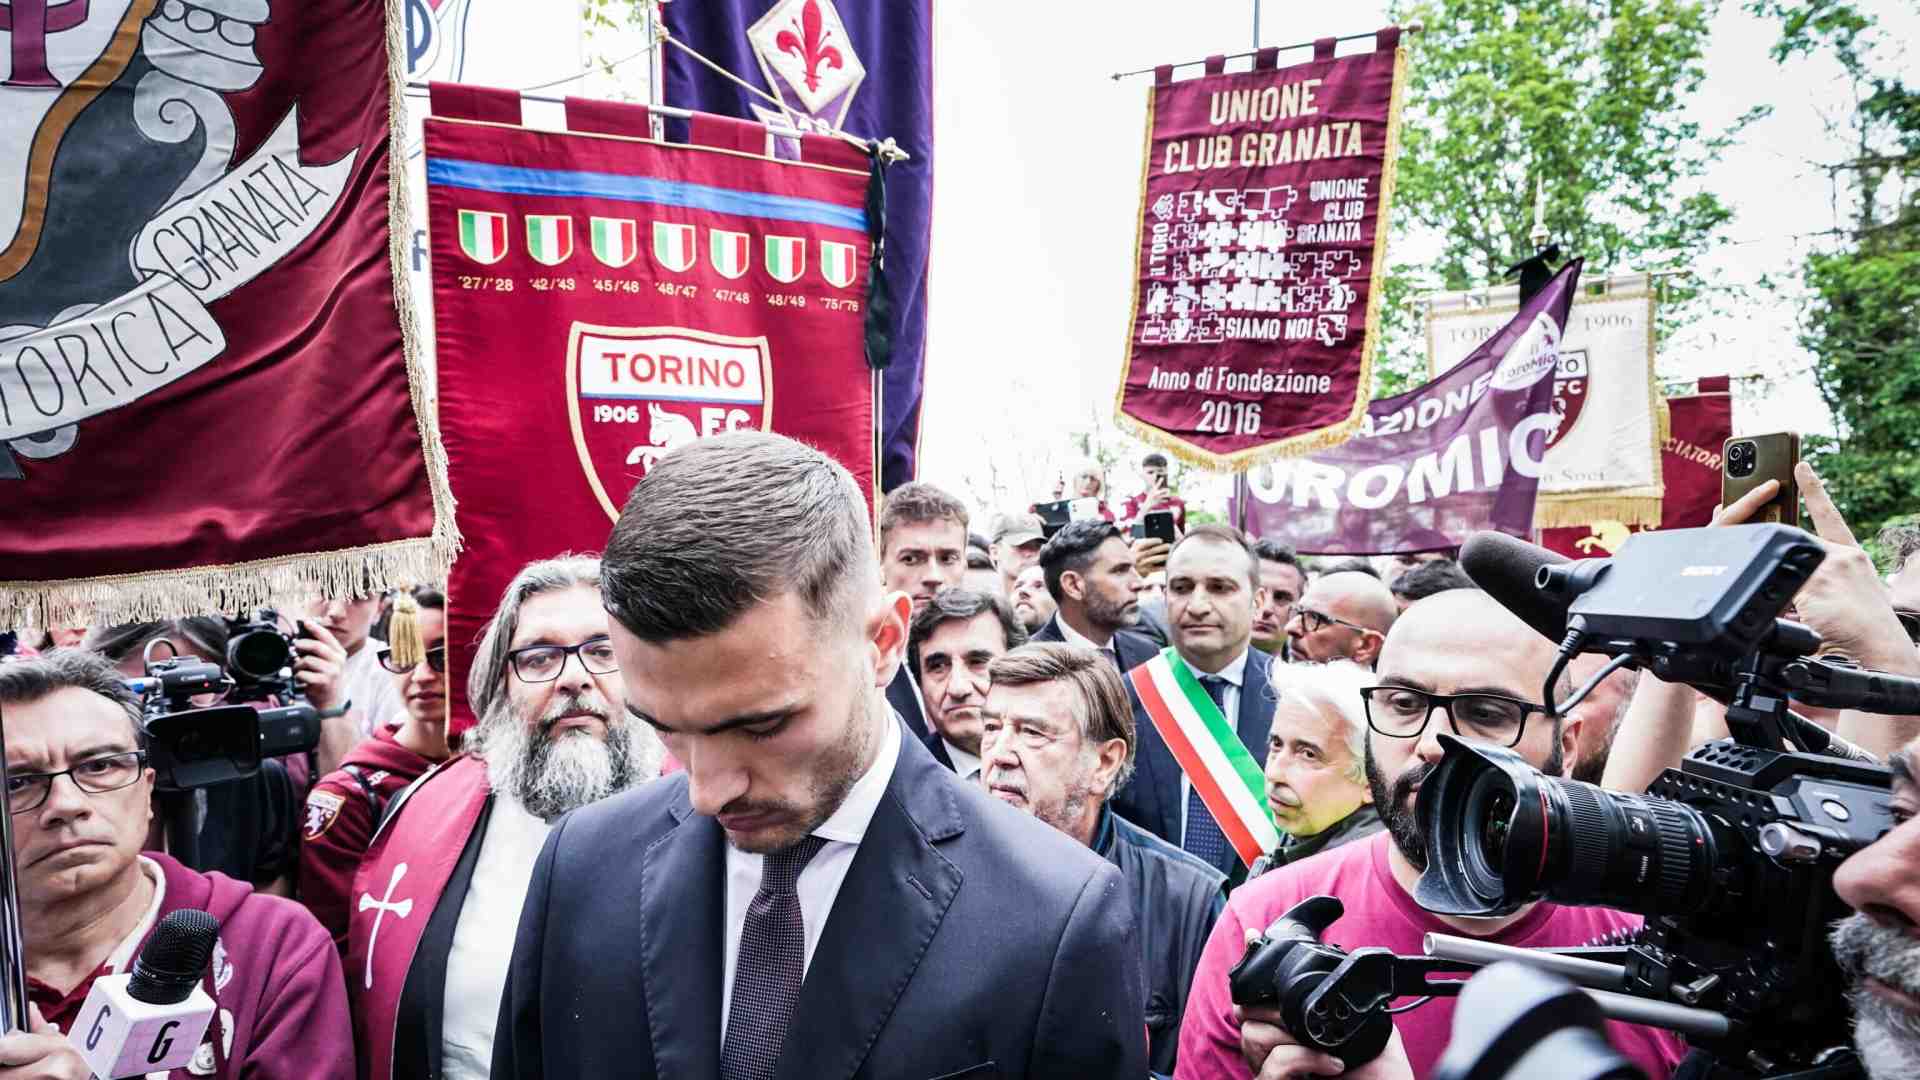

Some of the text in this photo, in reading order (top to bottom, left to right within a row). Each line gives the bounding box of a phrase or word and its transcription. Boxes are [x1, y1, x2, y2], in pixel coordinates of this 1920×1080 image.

[1209, 79, 1322, 126] UNIONE
[1163, 121, 1363, 174] CLUB GRANATA
[1309, 178, 1369, 202] UNIONE
[153, 154, 328, 291] GRANATA
[1323, 201, 1366, 221] CLUB
[1149, 222, 1169, 264] TORO
[1296, 221, 1361, 244] GRANATA
[1225, 317, 1315, 340] SIAMO NOI
[1448, 324, 1499, 342] TOR
[602, 352, 745, 388] TORINO
[1148, 366, 1331, 394] Anno di Fondazione
[1553, 380, 1583, 395] FC
[593, 405, 640, 423] 1906
[1196, 399, 1262, 435] 2016
[1357, 369, 1494, 438] AZIONE
[1247, 411, 1556, 512] OROMIO
[1662, 436, 1723, 471] CIATOR
[86, 1003, 112, 1052] G
[146, 1020, 181, 1065] G
